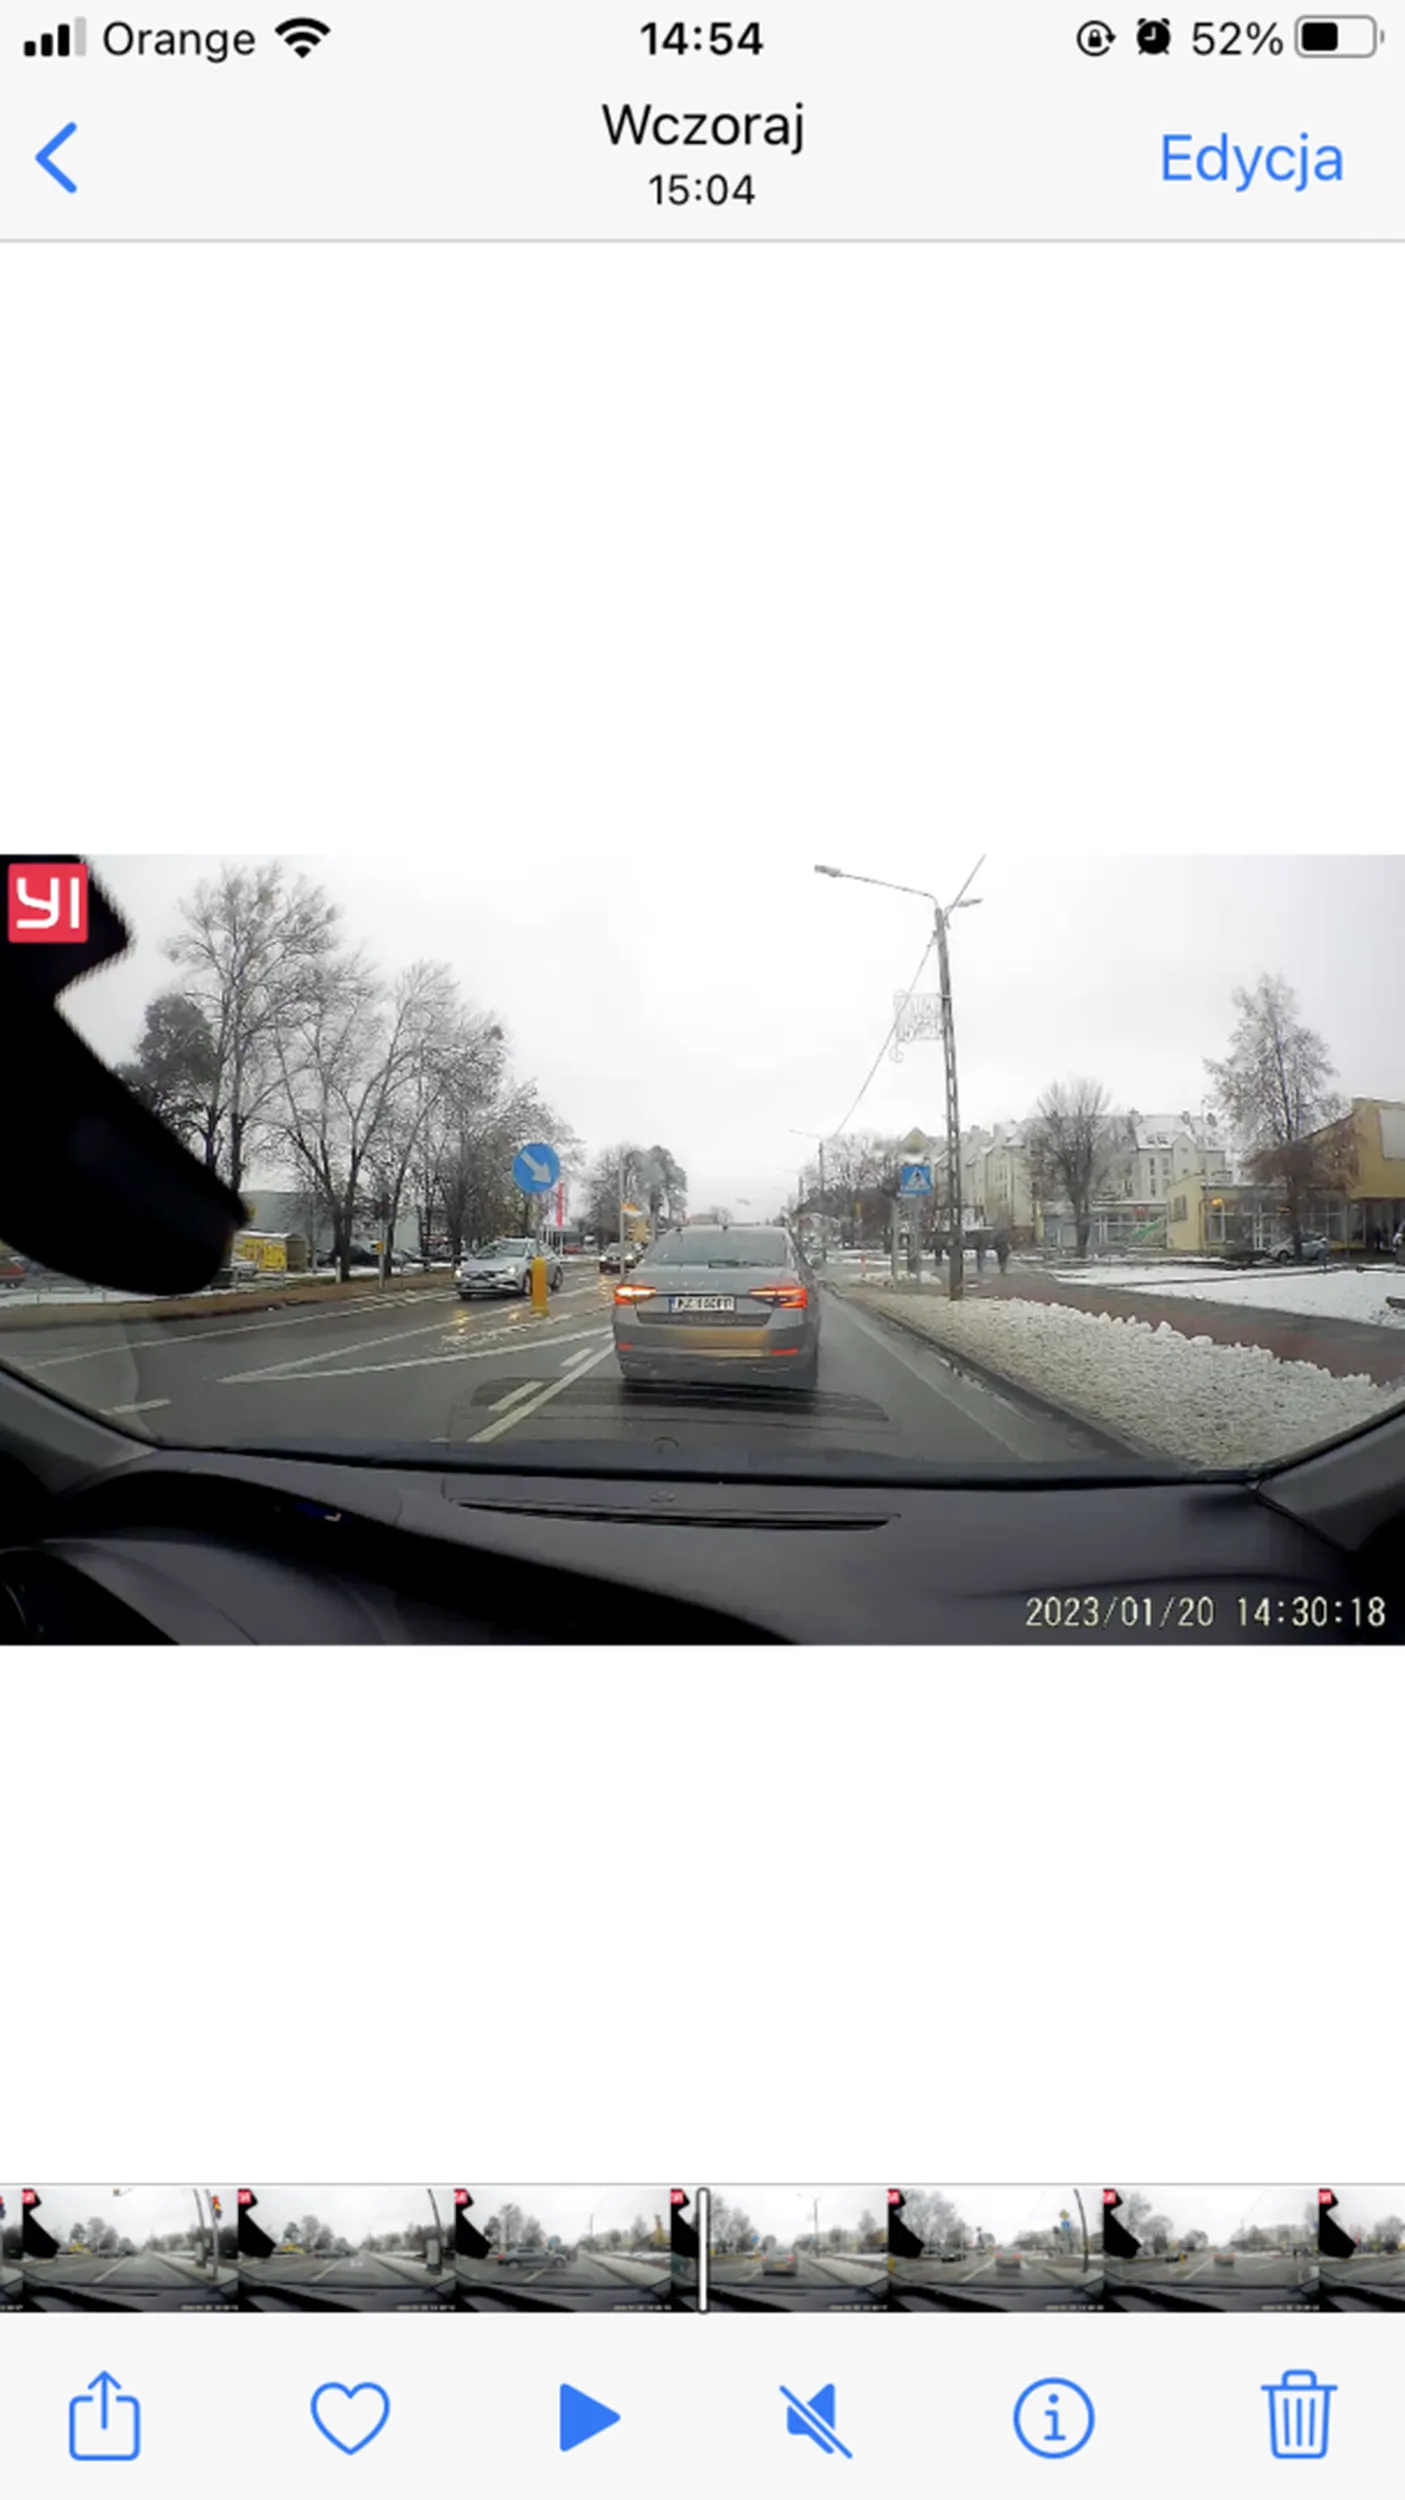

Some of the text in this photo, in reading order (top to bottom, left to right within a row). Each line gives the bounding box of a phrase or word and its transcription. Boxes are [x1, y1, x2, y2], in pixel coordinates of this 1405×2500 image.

[102, 20, 256, 65] Orange
[640, 21, 765, 57] 14:54
[1192, 20, 1284, 57] 52%
[601, 101, 804, 156] Wczoraj
[1162, 131, 1343, 193] Edycja
[648, 173, 756, 207] 15:04
